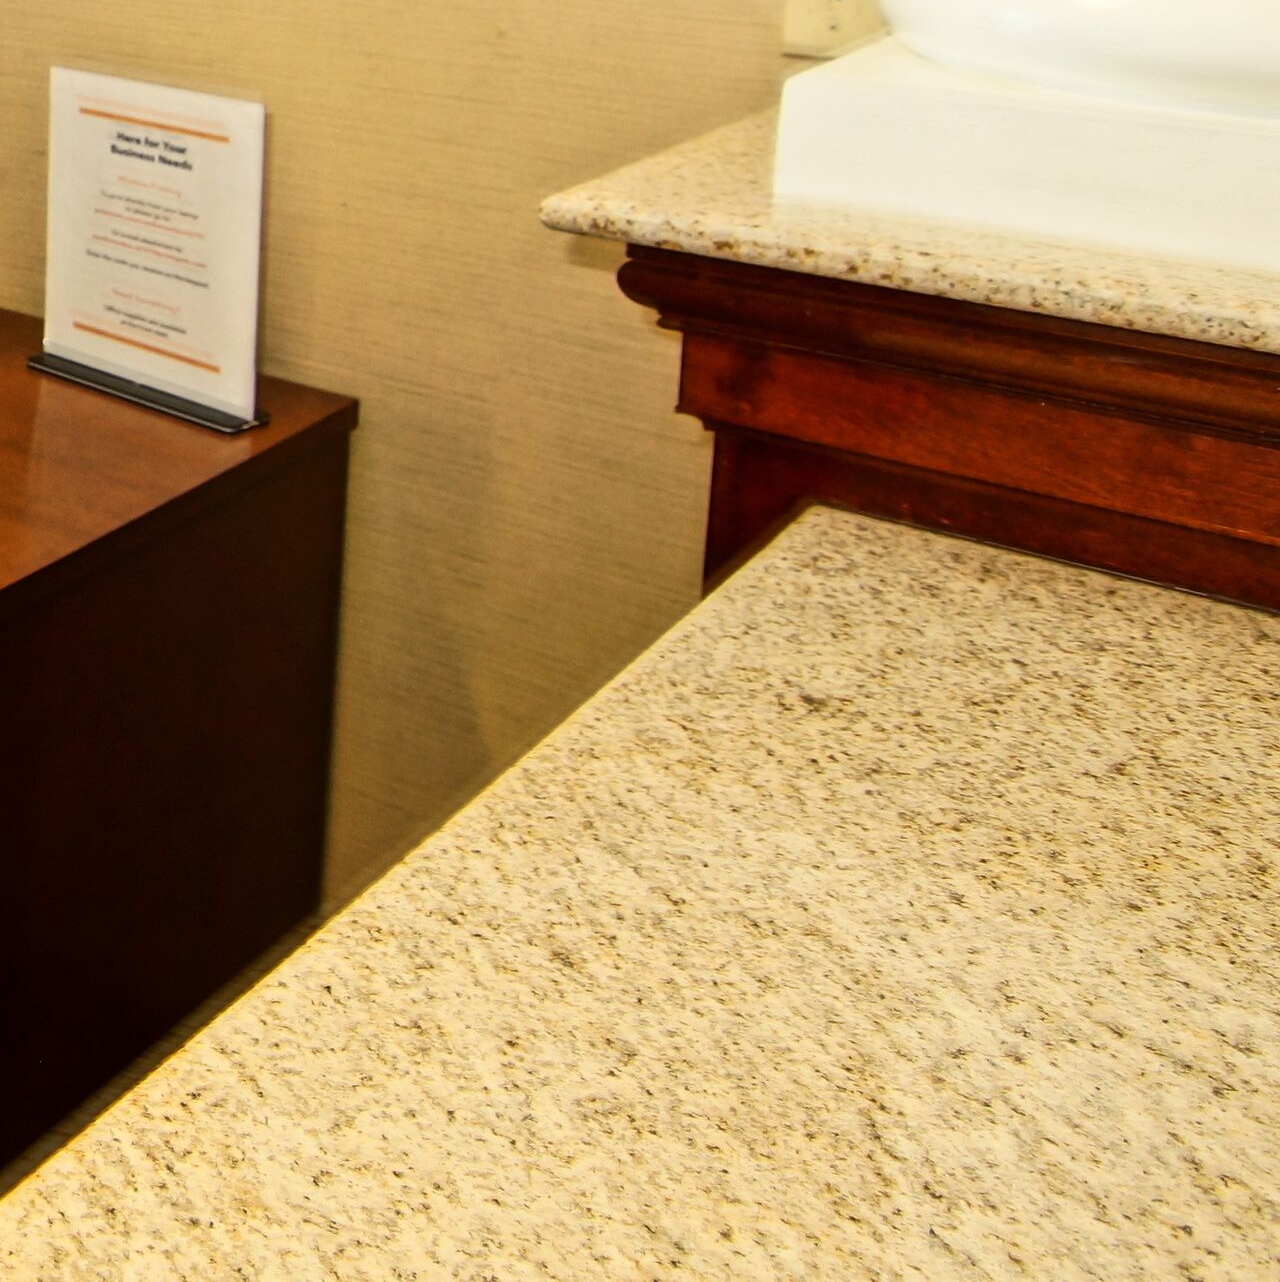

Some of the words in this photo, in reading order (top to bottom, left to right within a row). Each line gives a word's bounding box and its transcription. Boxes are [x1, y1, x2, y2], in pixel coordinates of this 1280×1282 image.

[144, 136, 159, 148] for
[110, 143, 155, 162] Business
[158, 153, 192, 171] Needs
